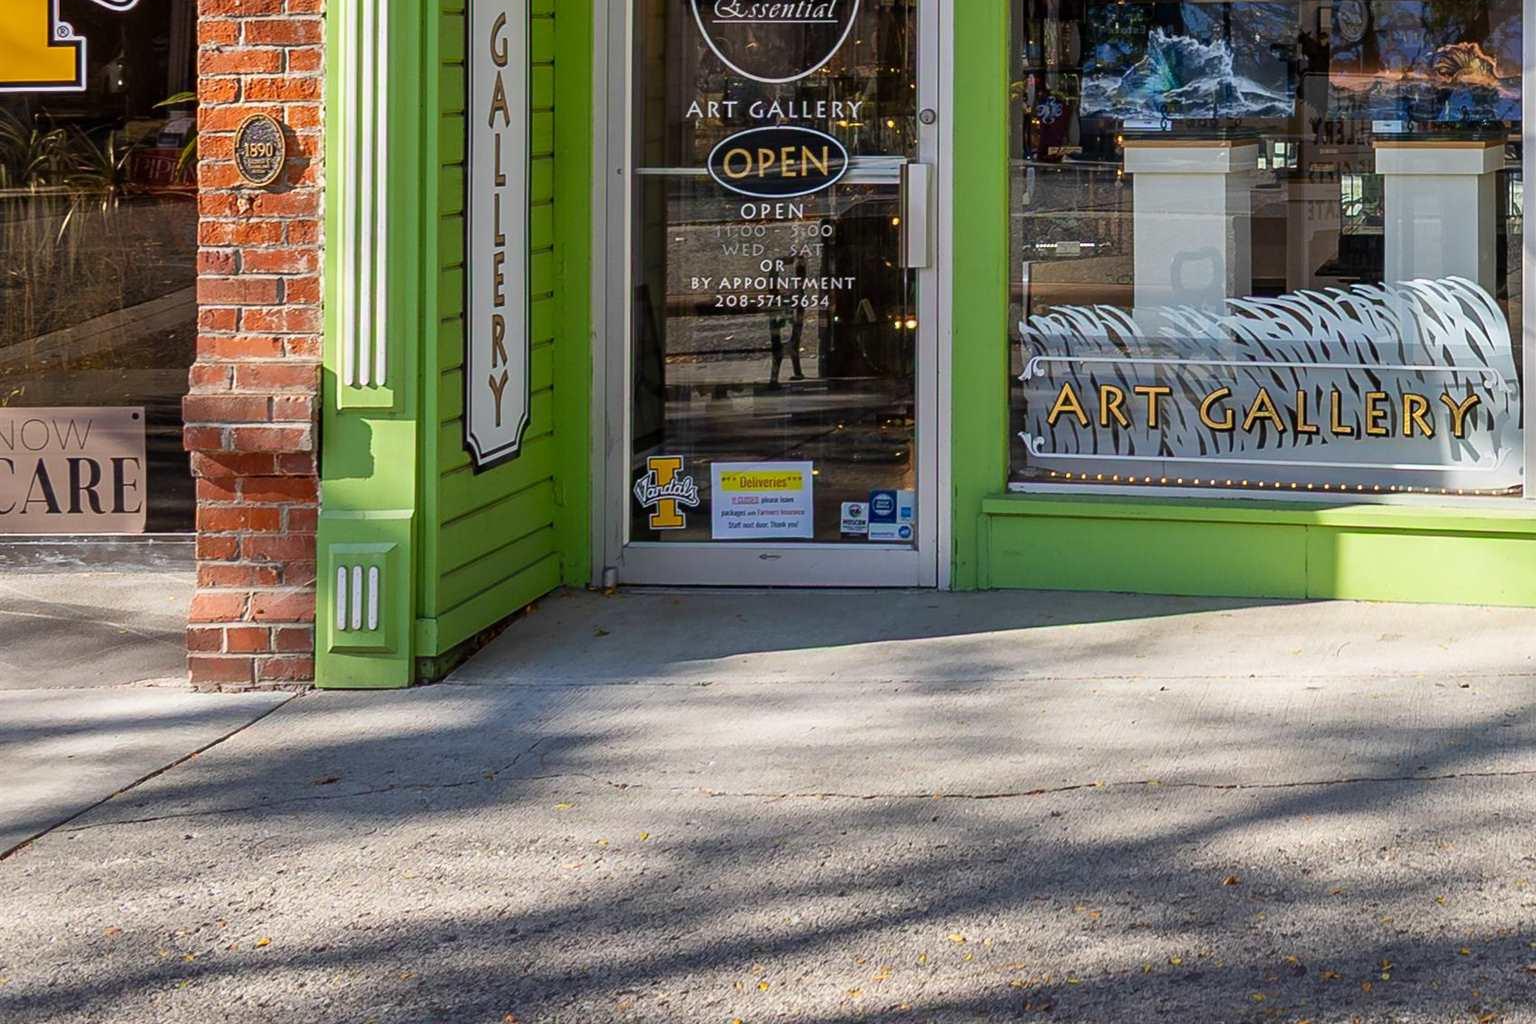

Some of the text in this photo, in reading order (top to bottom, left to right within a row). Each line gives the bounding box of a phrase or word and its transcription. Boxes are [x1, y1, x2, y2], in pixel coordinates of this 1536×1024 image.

[685, 100, 864, 119] ART GALLERY
[244, 142, 274, 157] 1890
[723, 145, 829, 179] OPEN
[488, 12, 511, 428] GALLERY
[740, 203, 804, 220] OPEN
[722, 243, 765, 256] WED
[790, 243, 824, 256] SAT
[760, 259, 785, 272] OR
[690, 277, 856, 290] BY APPOINTMENT
[715, 294, 830, 308] 208-571-5654
[1046, 381, 1482, 440] ART GALLERY
[634, 475, 698, 505] Vandals
